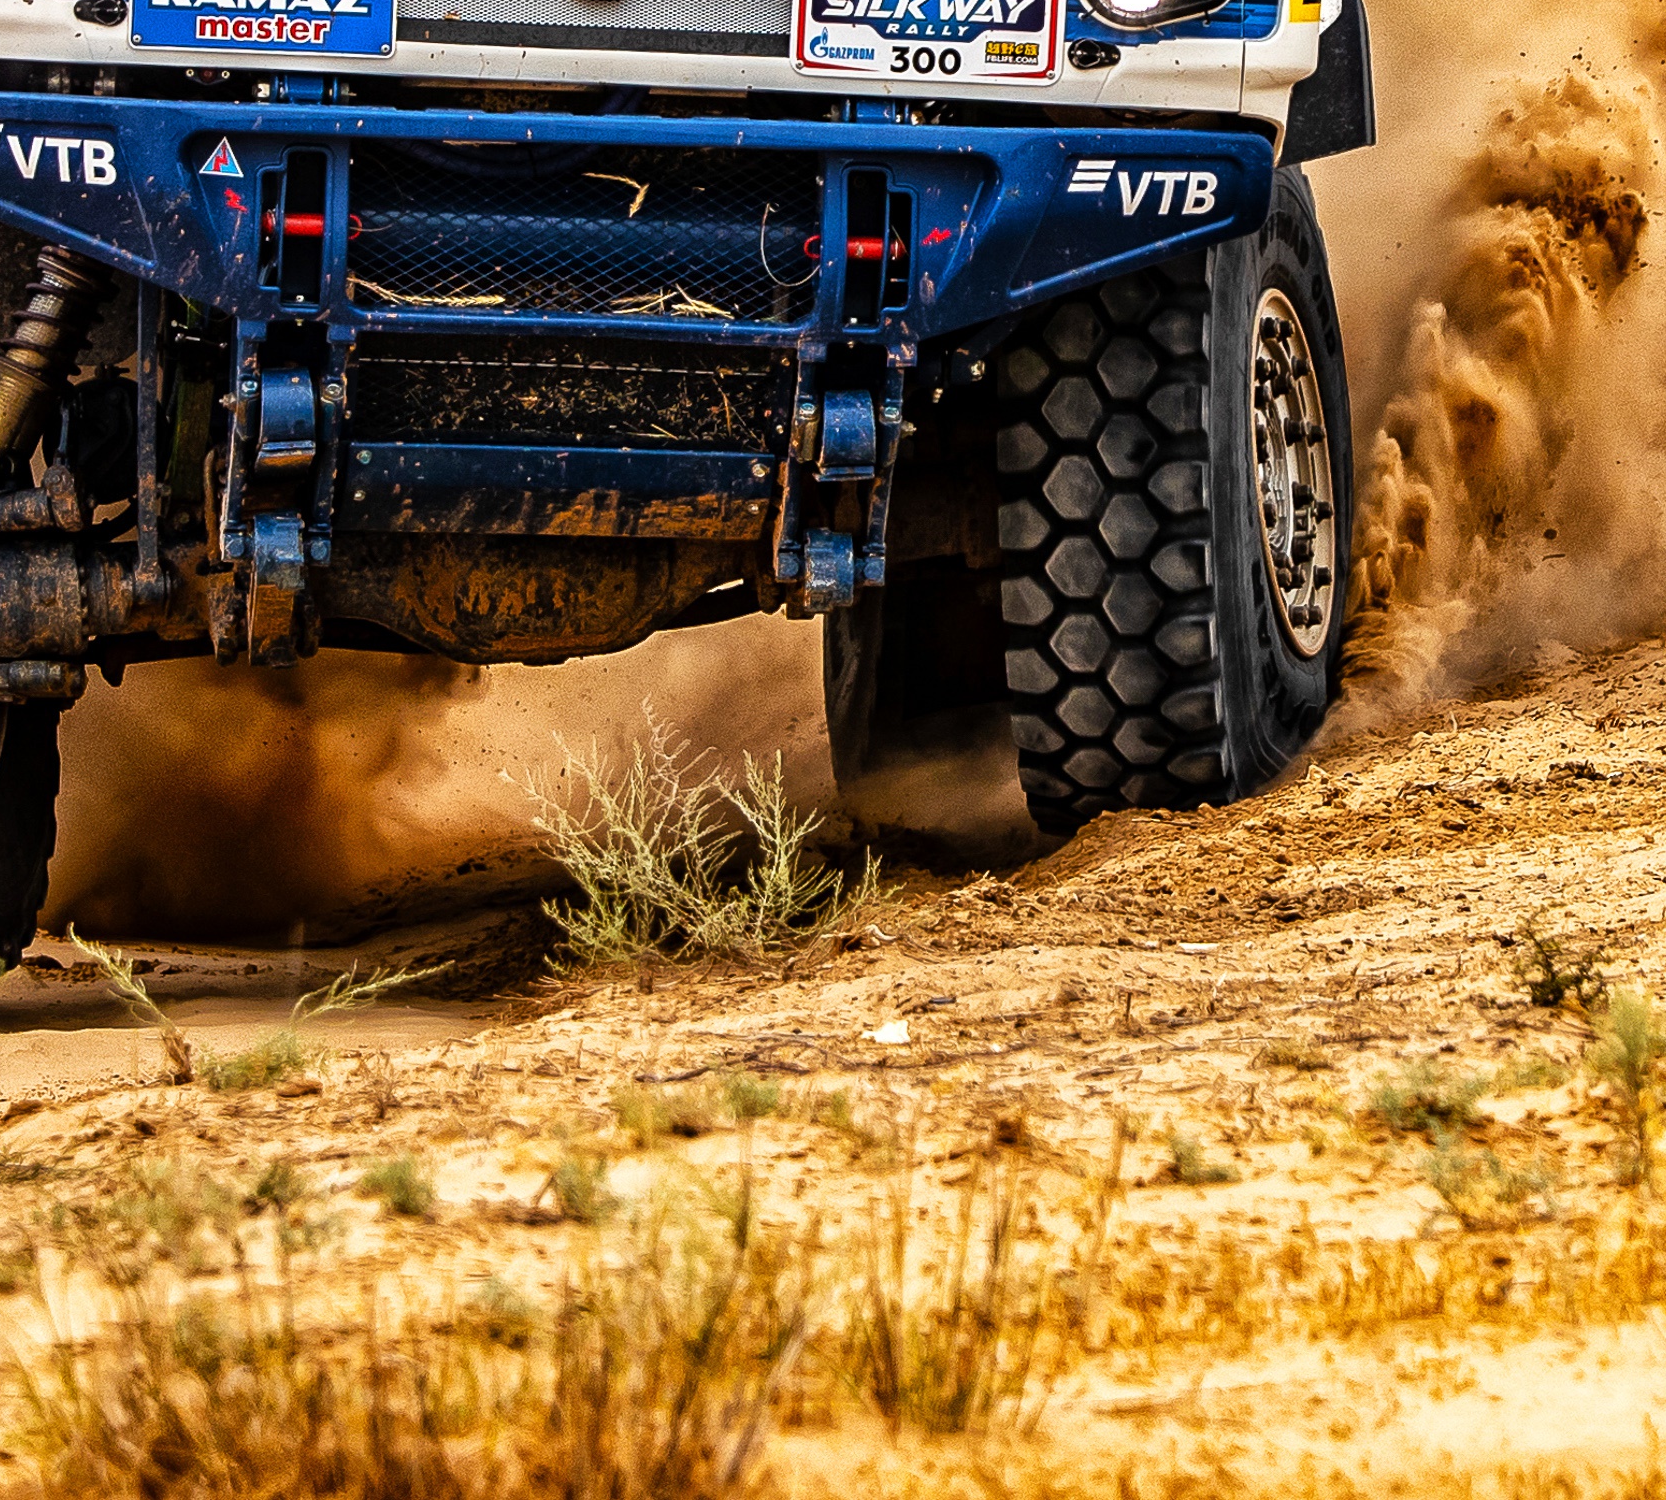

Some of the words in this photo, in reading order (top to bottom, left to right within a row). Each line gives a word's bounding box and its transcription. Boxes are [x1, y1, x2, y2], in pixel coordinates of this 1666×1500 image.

[197, 17, 330, 42] master
[886, 24, 970, 37] RALLY
[828, 47, 875, 60] GAZPROM
[890, 46, 961, 75] 300
[986, 55, 1037, 64] FBLIFE.COM
[6, 135, 117, 185] VTB
[1117, 171, 1218, 215] VTB
